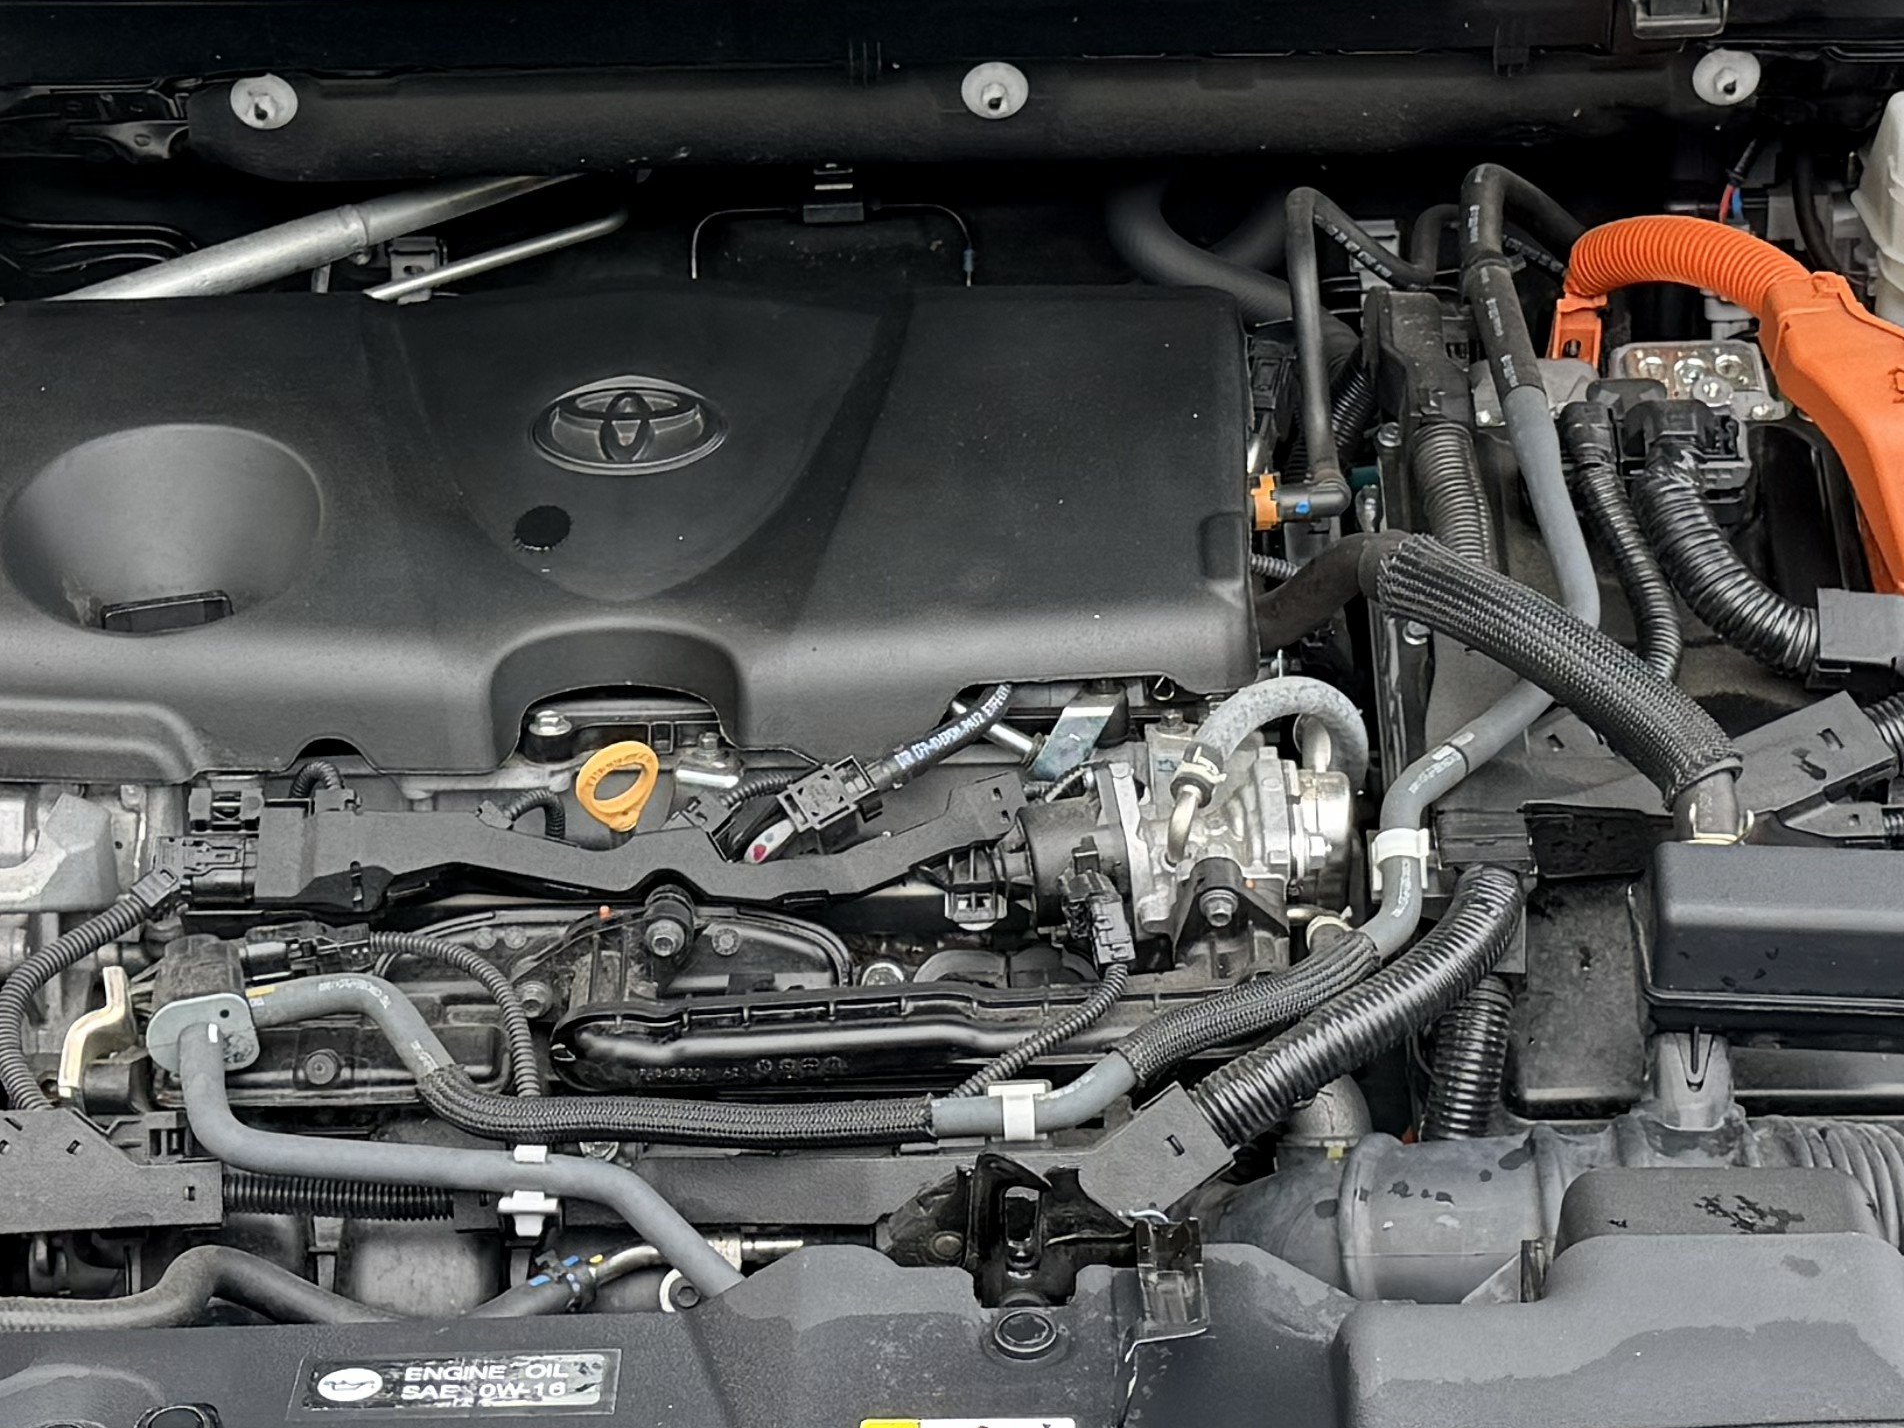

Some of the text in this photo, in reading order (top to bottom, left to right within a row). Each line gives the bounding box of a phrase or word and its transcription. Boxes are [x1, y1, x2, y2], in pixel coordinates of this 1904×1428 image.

[404, 1363, 570, 1382] ENGINE OIL
[400, 1382, 567, 1401] SAE 0W-16
